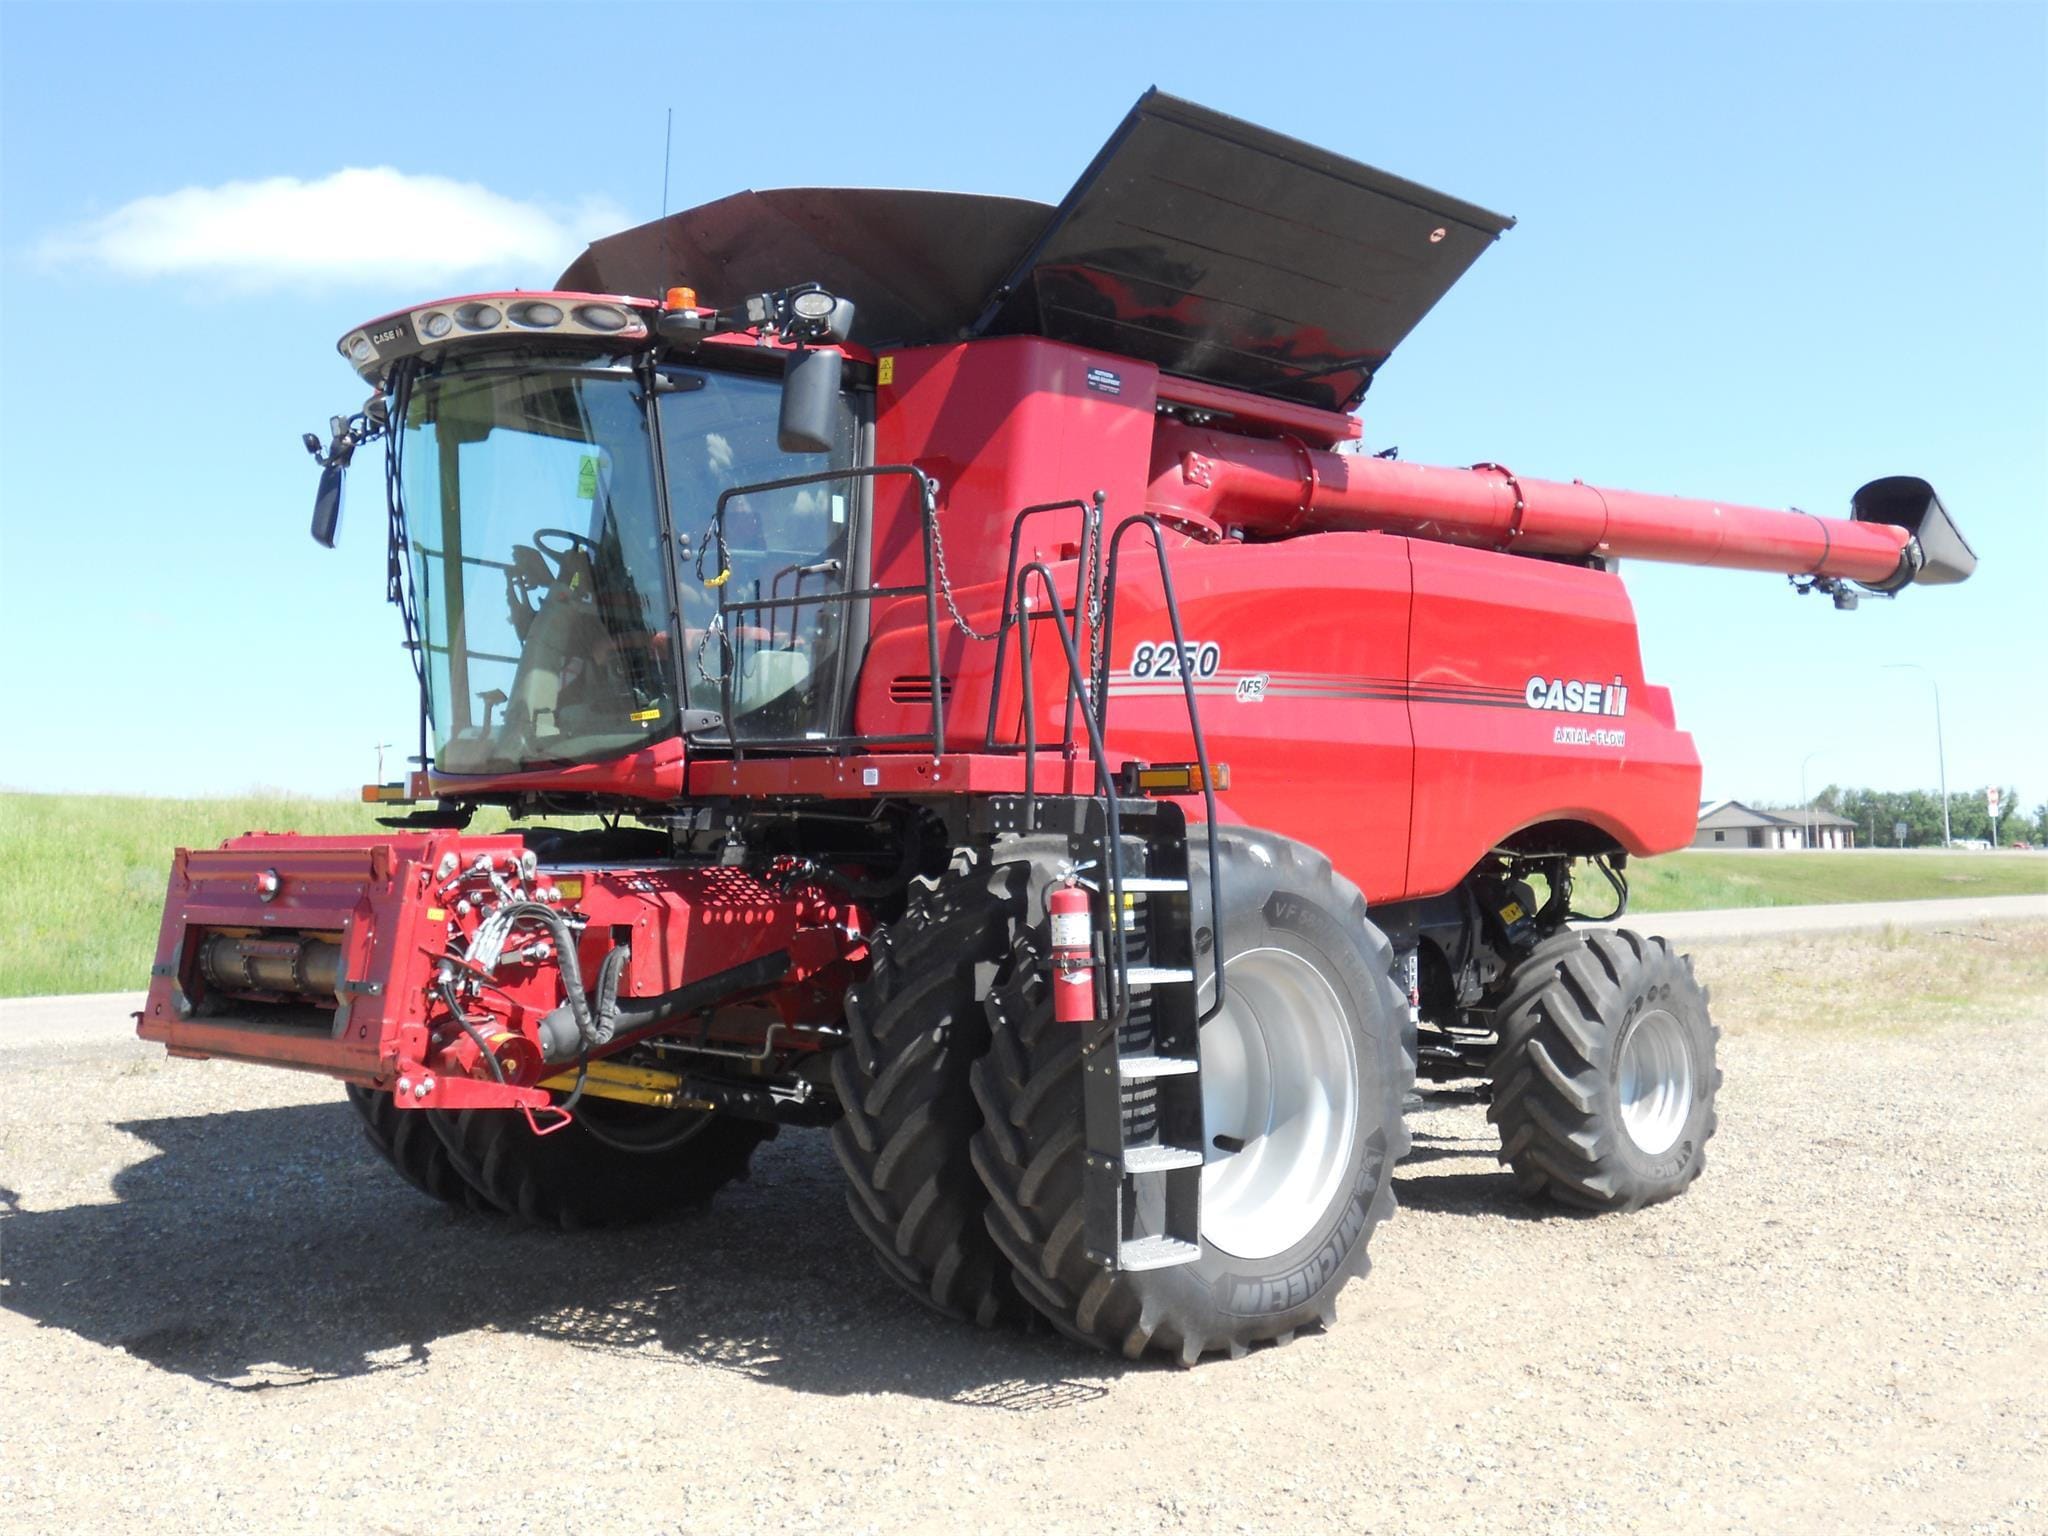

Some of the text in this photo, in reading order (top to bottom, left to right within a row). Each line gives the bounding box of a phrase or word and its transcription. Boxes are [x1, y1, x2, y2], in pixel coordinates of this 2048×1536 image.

[373, 330, 395, 344] CASE
[1131, 643, 1220, 679] 8250
[1238, 679, 1262, 693] AFS
[1525, 675, 1602, 714] CASE
[1554, 727, 1625, 747] AXIAL-FLOW
[1229, 1199, 1366, 1313] MICHELIN
